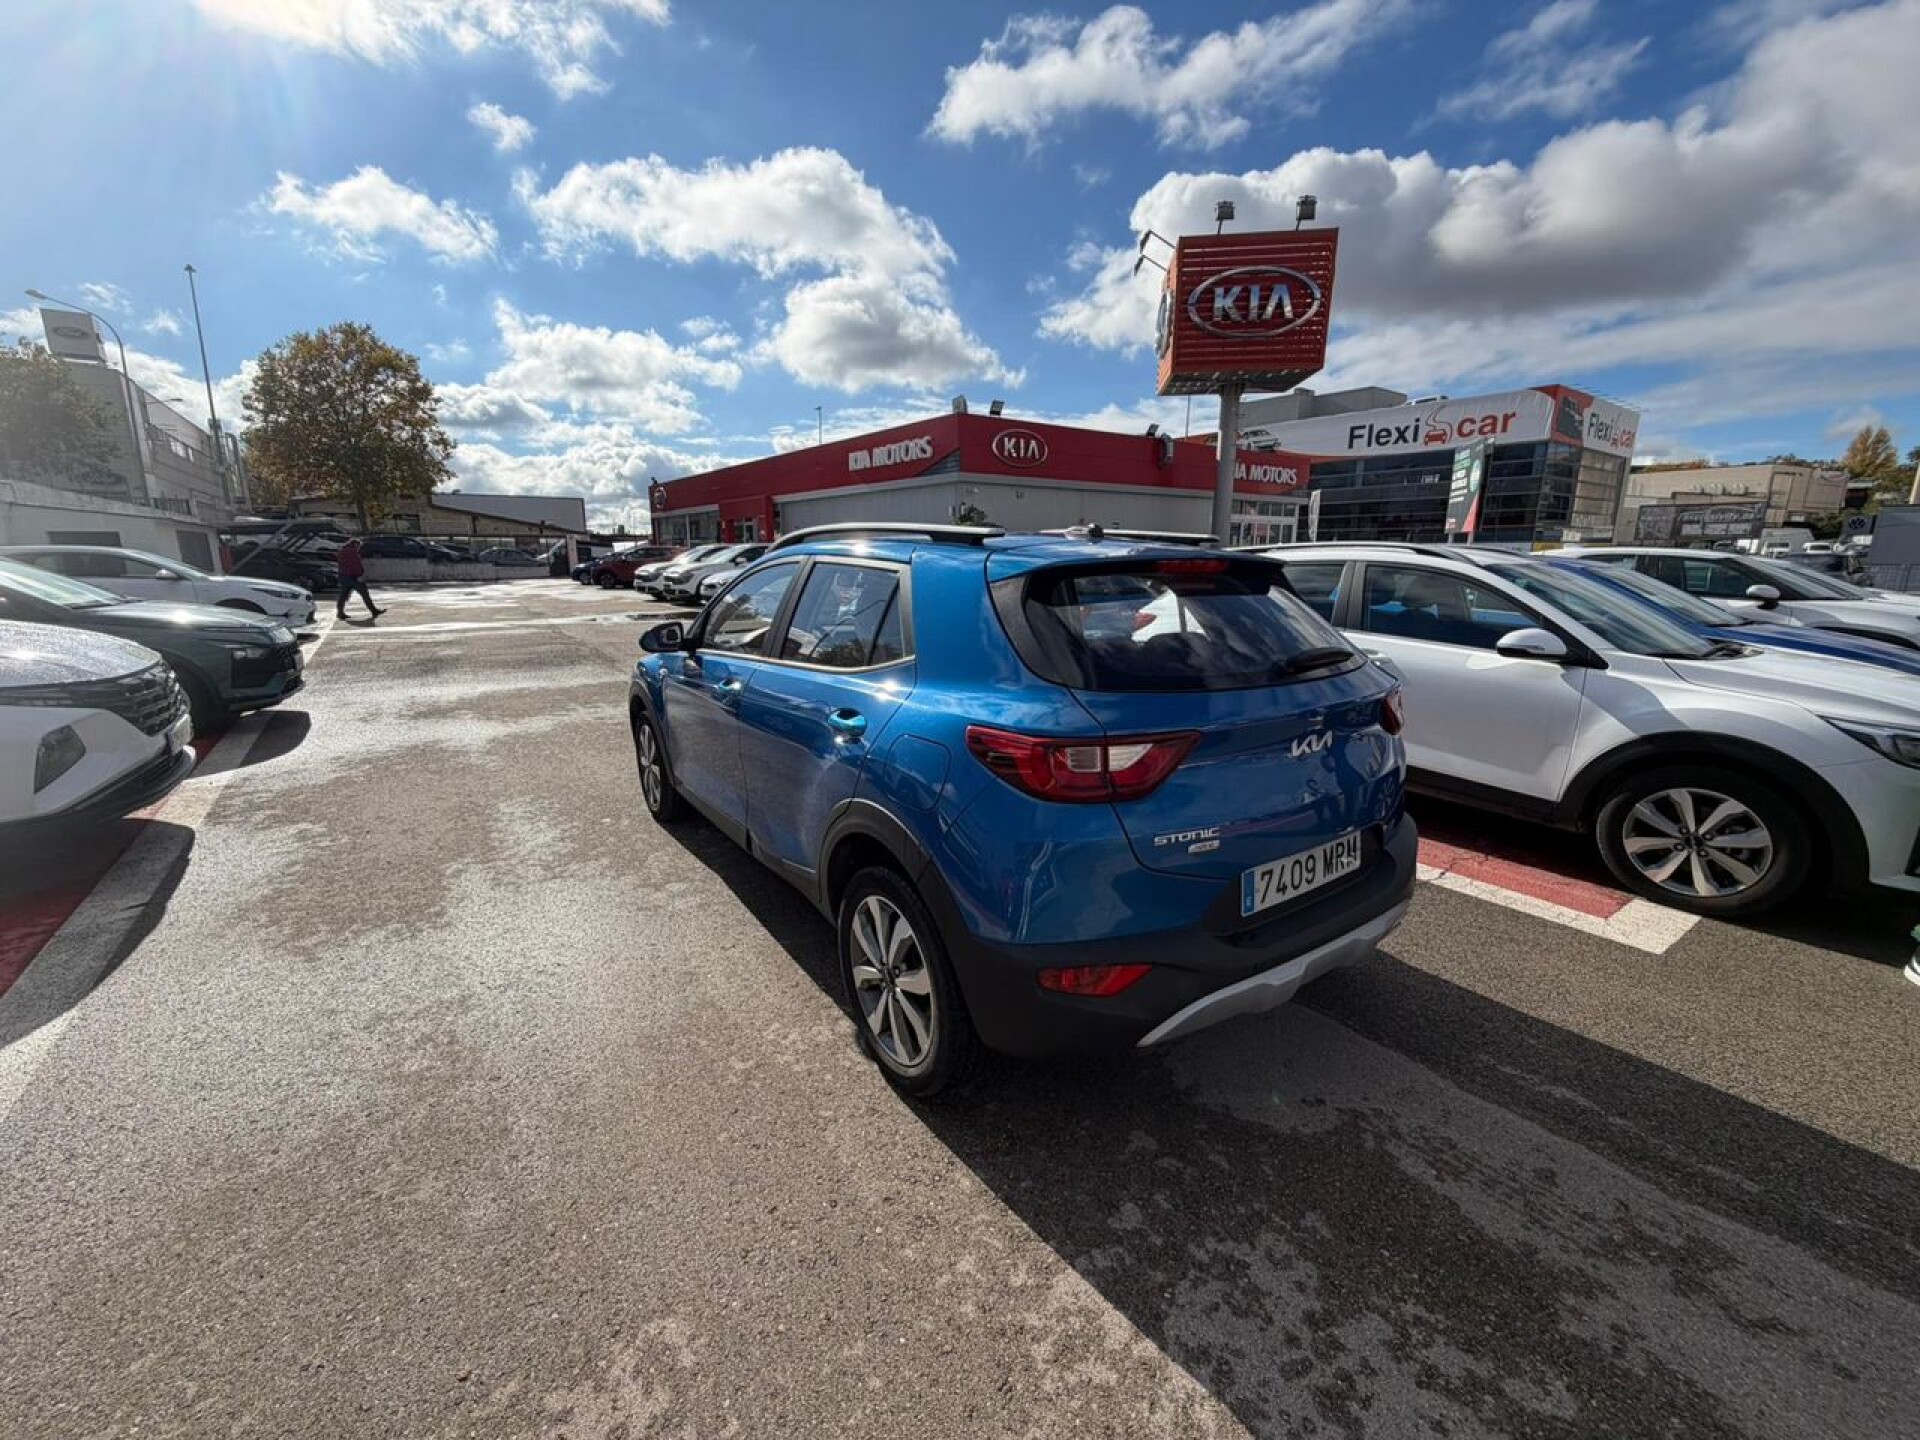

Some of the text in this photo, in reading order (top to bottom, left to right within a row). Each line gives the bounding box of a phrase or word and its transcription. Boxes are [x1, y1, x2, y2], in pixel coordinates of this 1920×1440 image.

[1213, 283, 1294, 322] KIA
[1347, 411, 1516, 450] Flexi car
[1587, 412, 1614, 442] Flexi
[849, 436, 933, 471] KIA MOTORS
[1003, 437, 1039, 460] KIA
[1249, 465, 1297, 485] MOTORS
[1154, 827, 1220, 846] STONIC
[1260, 854, 1317, 905] 7409
